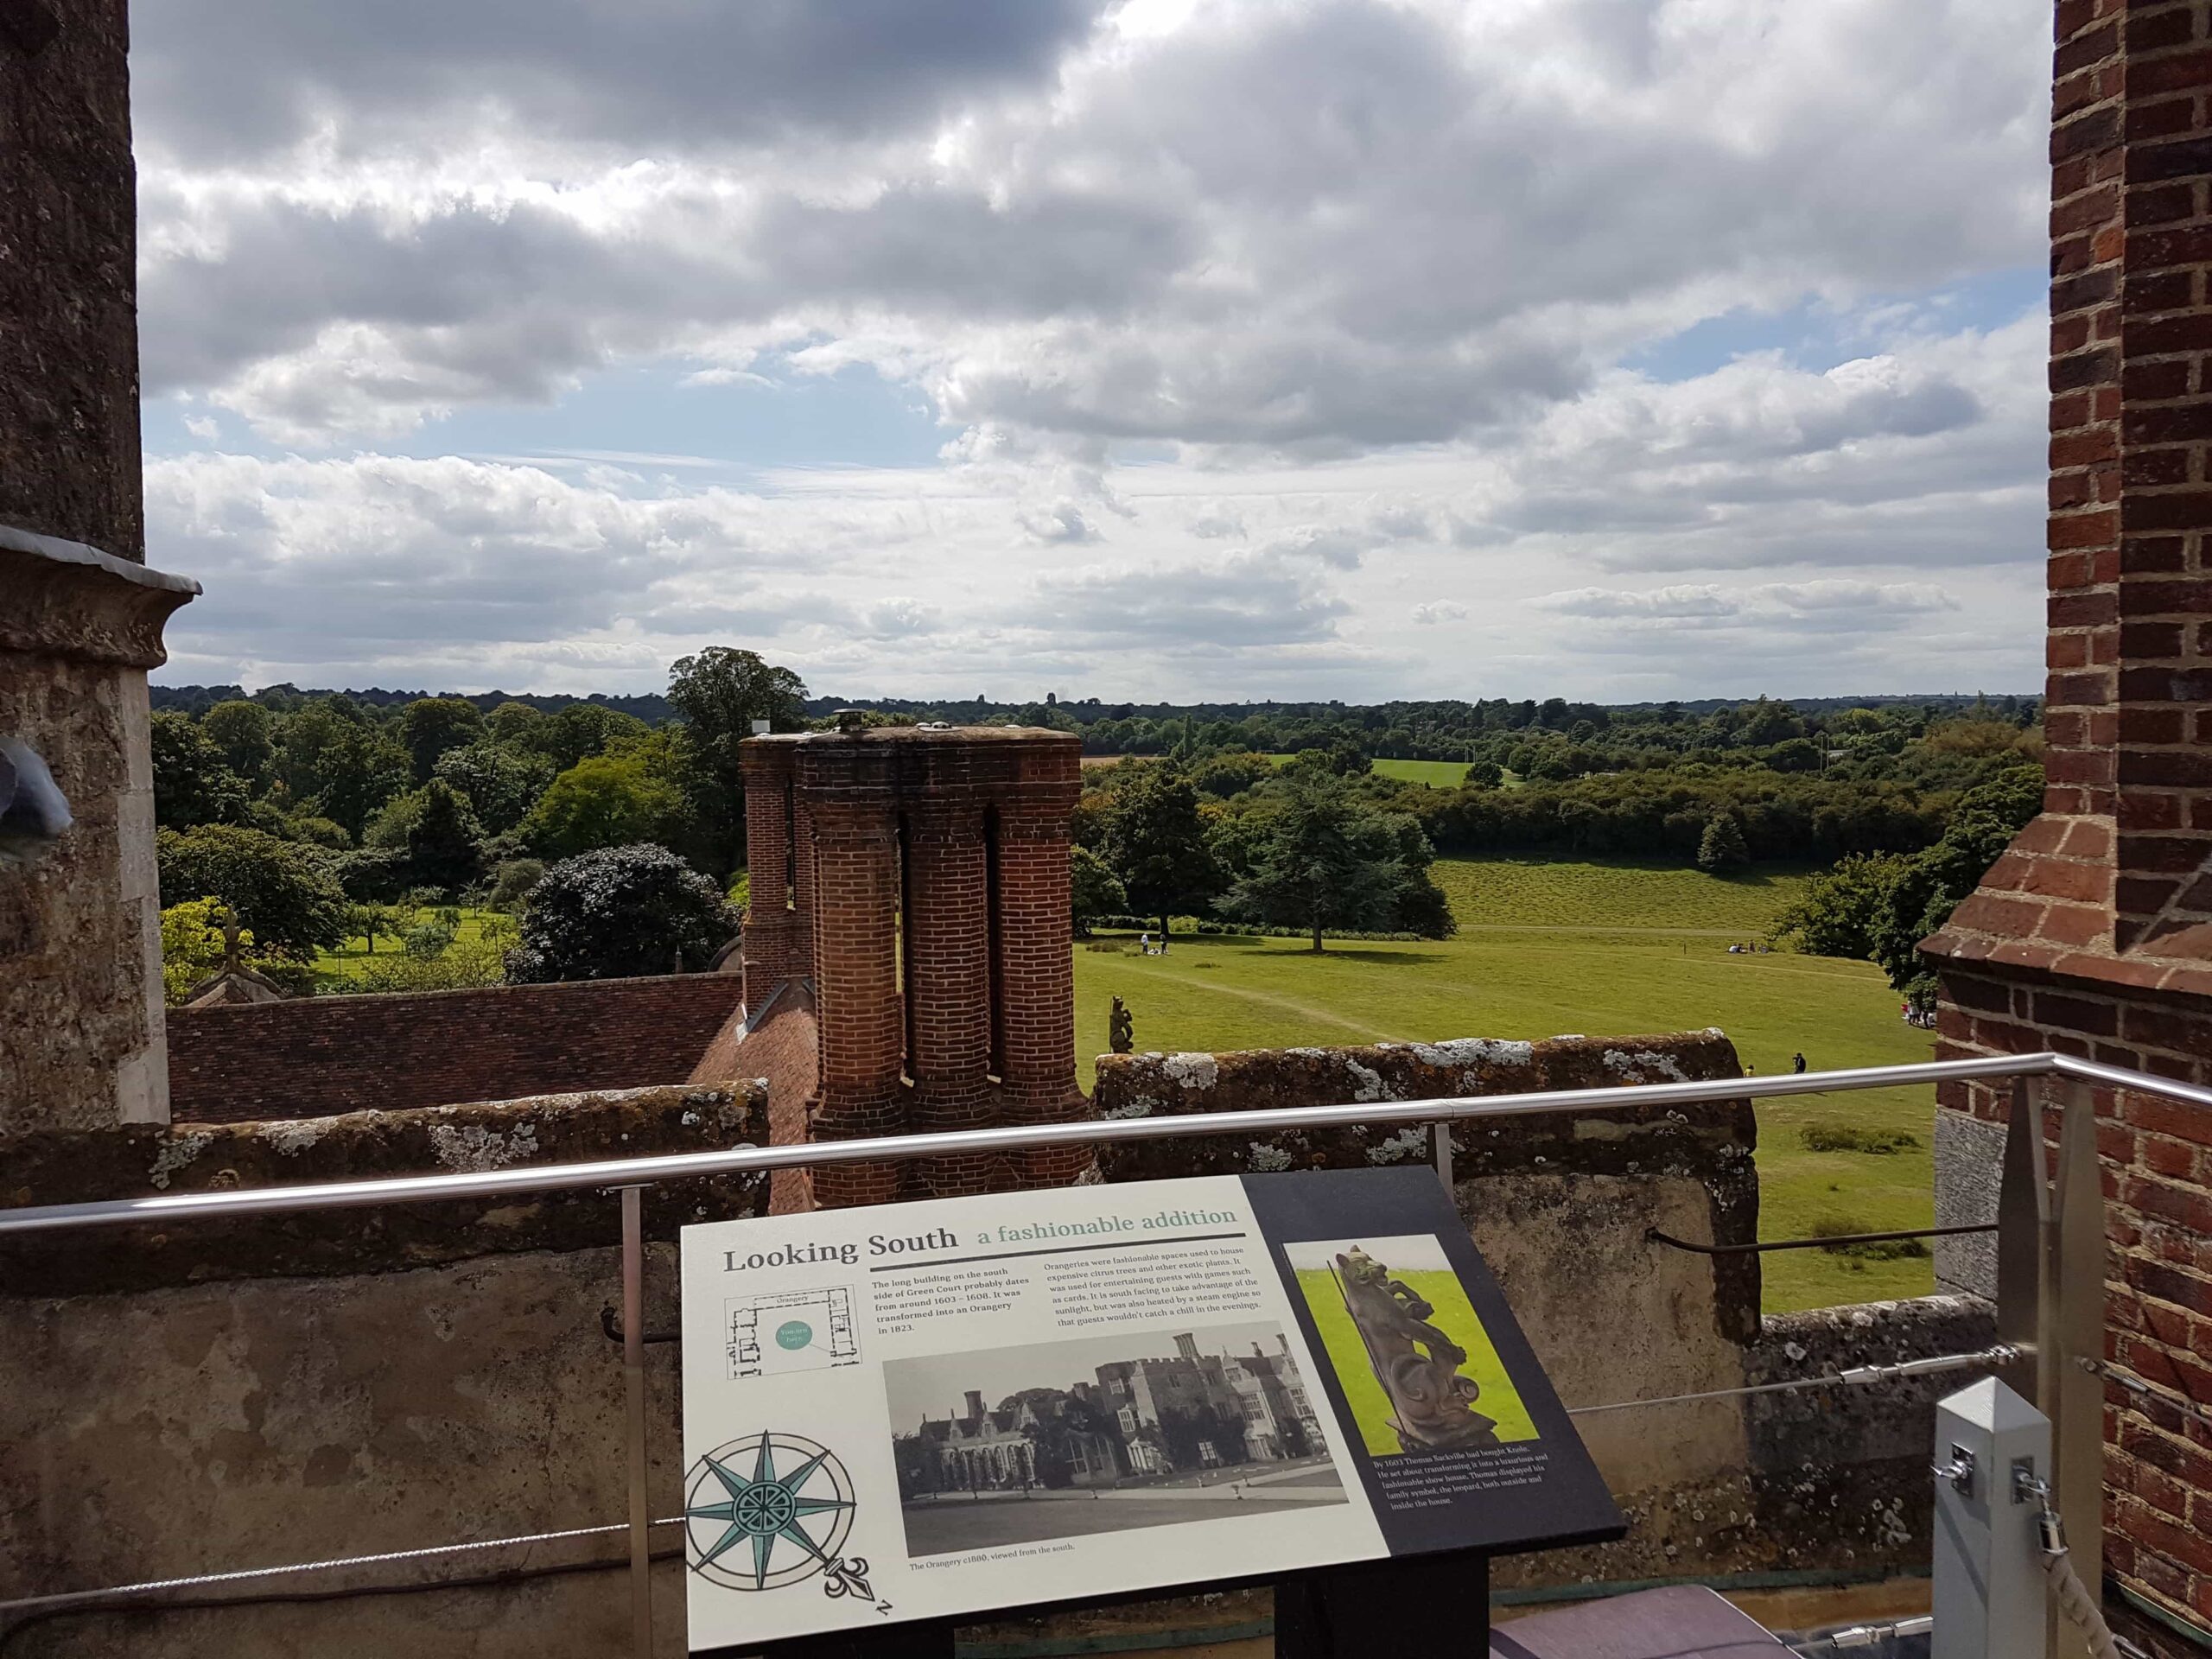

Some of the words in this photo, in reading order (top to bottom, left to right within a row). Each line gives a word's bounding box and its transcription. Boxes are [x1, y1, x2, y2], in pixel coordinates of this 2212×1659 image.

[723, 1243, 859, 1273] Looking
[868, 1228, 959, 1255] South
[977, 1232, 990, 1244] a
[998, 1217, 1135, 1243] fashionable
[1141, 1208, 1237, 1229] addition
[1044, 1262, 1089, 1270] Orangeries
[1113, 1253, 1159, 1264] fashionable
[1047, 1272, 1088, 1282] expensive
[1206, 1259, 1232, 1268] plants.
[914, 1275, 950, 1284] building
[964, 1281, 1003, 1291] probably
[1006, 1277, 1029, 1286] dates
[1103, 1276, 1154, 1287] entertaining
[1156, 1274, 1182, 1284] guests
[1109, 1289, 1132, 1298] south
[1134, 1287, 1160, 1296] facing
[1192, 1281, 1233, 1291] advantage
[899, 1299, 931, 1308] around
[935, 1296, 957, 1305] 1603
[966, 1293, 991, 1302] 1608.
[1055, 1305, 1092, 1315] sunlight,
[1177, 1296, 1186, 1305] by
[1222, 1291, 1249, 1300] engine
[877, 1311, 933, 1323] transformed
[936, 1308, 954, 1317] into
[970, 1302, 1012, 1313] Orangery
[1077, 1317, 1104, 1325] guests
[1106, 1312, 1142, 1321] wouldn't
[1145, 1309, 1167, 1318] catch
[1177, 1306, 1194, 1315] chill
[1222, 1301, 1262, 1310] evenings.
[890, 1324, 915, 1332] 1823.
[1402, 1467, 1423, 1476] about
[1425, 1463, 1470, 1473] transforming
[1501, 1456, 1534, 1465] luxurious
[1406, 1457, 1433, 1465] Thomas
[1433, 1452, 1465, 1462] Sackville
[1382, 1479, 1423, 1490] fashionable
[1499, 1466, 1532, 1476] displayed
[1387, 1492, 1409, 1501] family
[1411, 1489, 1439, 1497] symbol,
[1453, 1483, 1482, 1493] leopard,
[1483, 1480, 1500, 1489] both
[1501, 1478, 1527, 1487] outside
[1390, 1502, 1414, 1510] inside
[1428, 1497, 1453, 1506] house.
[926, 1558, 962, 1568] Orangery
[963, 1554, 989, 1564] c1880,
[991, 1550, 1018, 1560] viewed
[1052, 1543, 1075, 1552] south.
[875, 1599, 893, 1616] N
